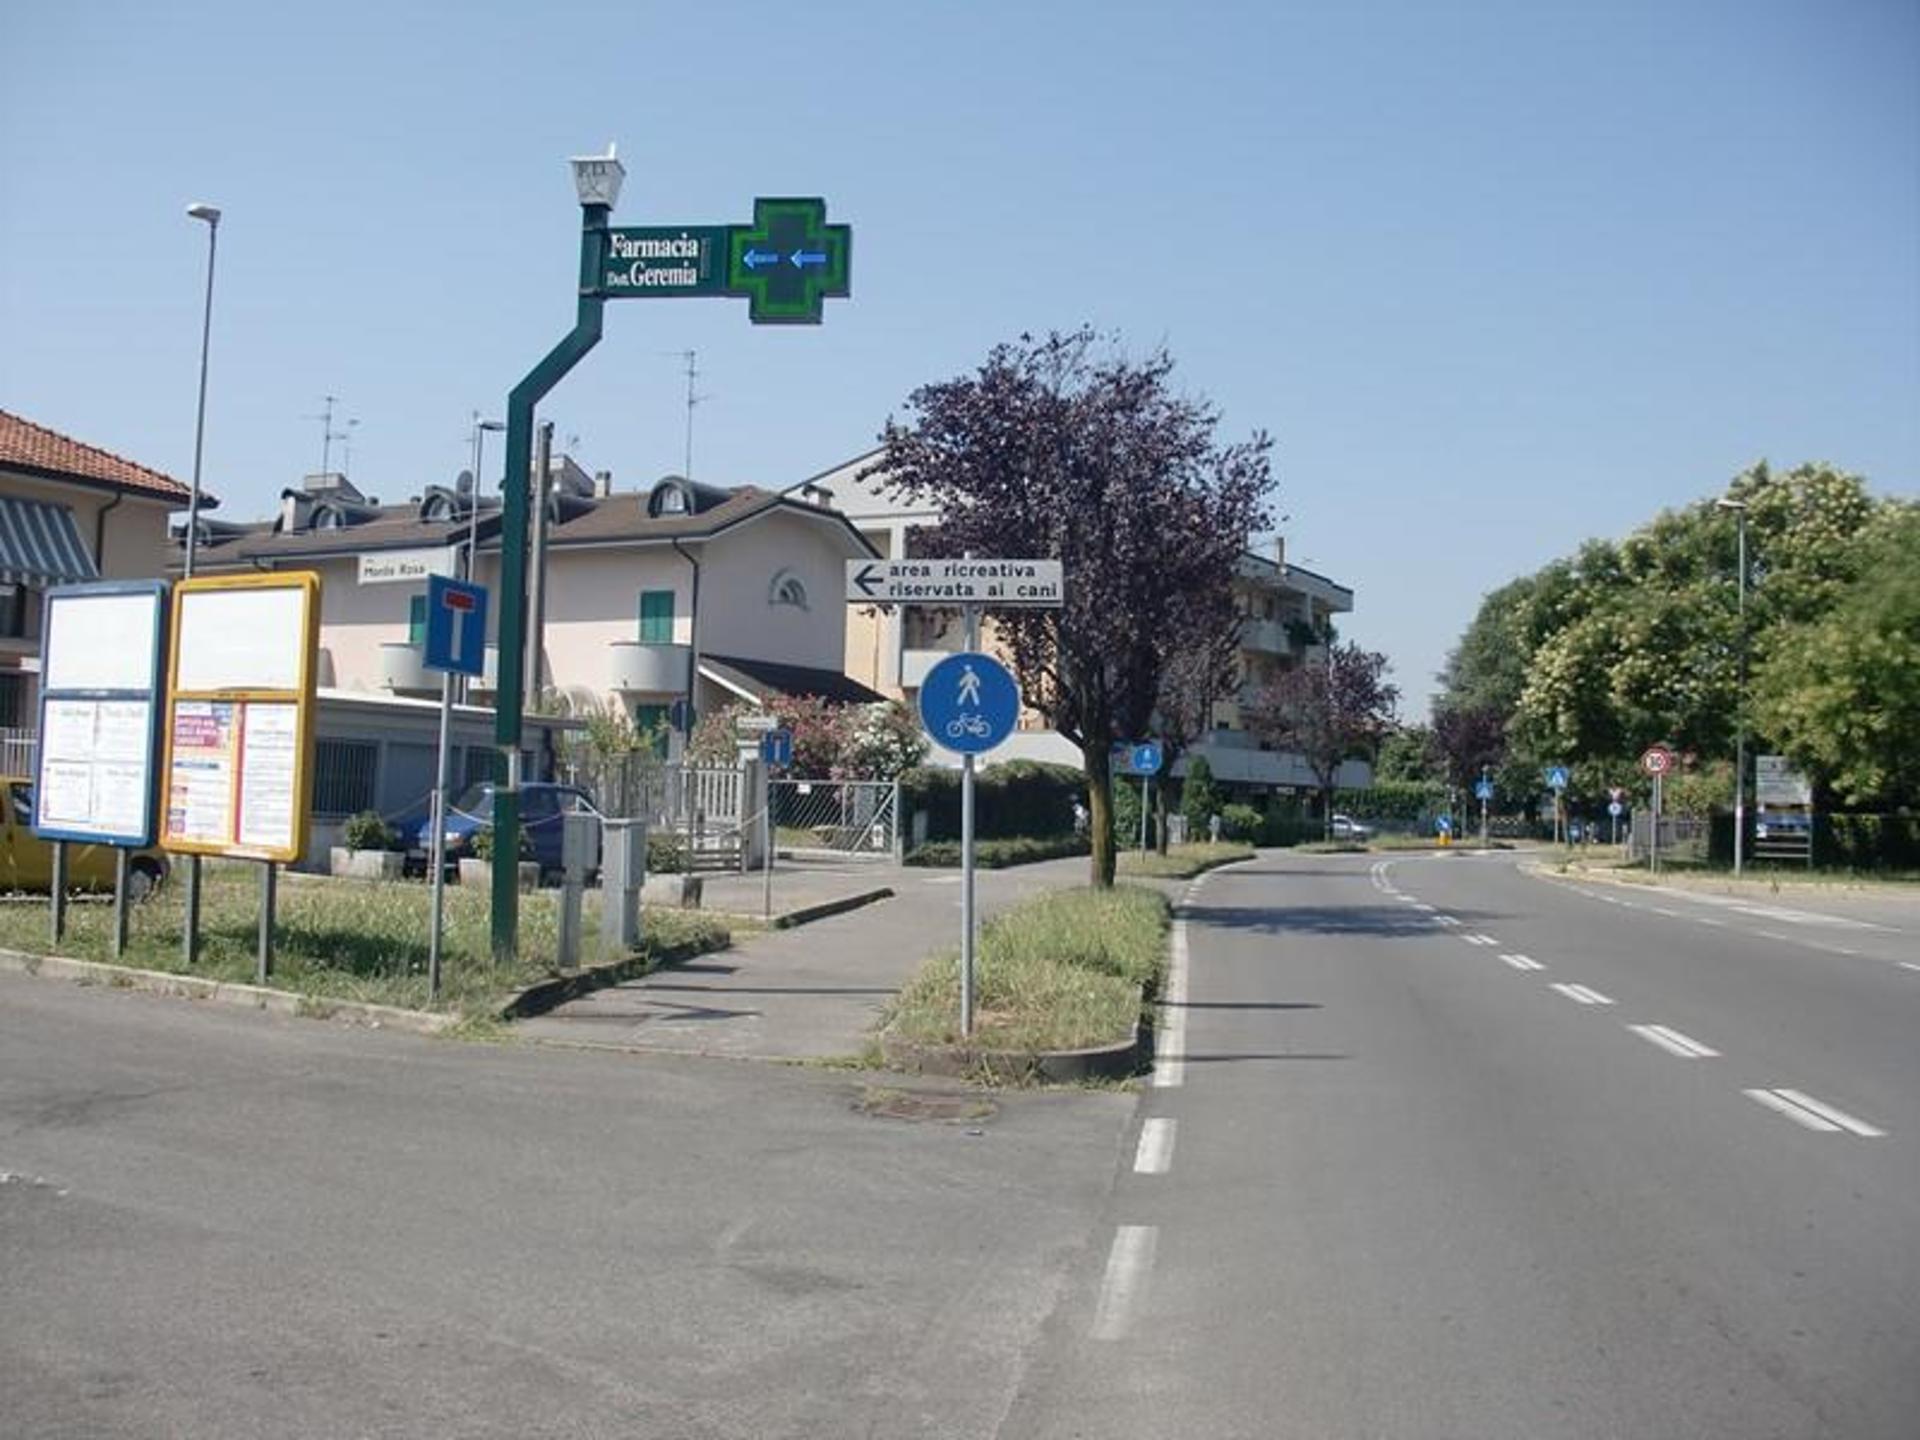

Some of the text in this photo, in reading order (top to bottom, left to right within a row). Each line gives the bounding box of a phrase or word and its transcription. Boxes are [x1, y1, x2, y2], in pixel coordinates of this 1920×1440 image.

[610, 232, 698, 257] Farmacia
[630, 260, 697, 286] Geremia
[889, 563, 1035, 577] area ricreativa
[889, 582, 1057, 596] riservata ai cani
